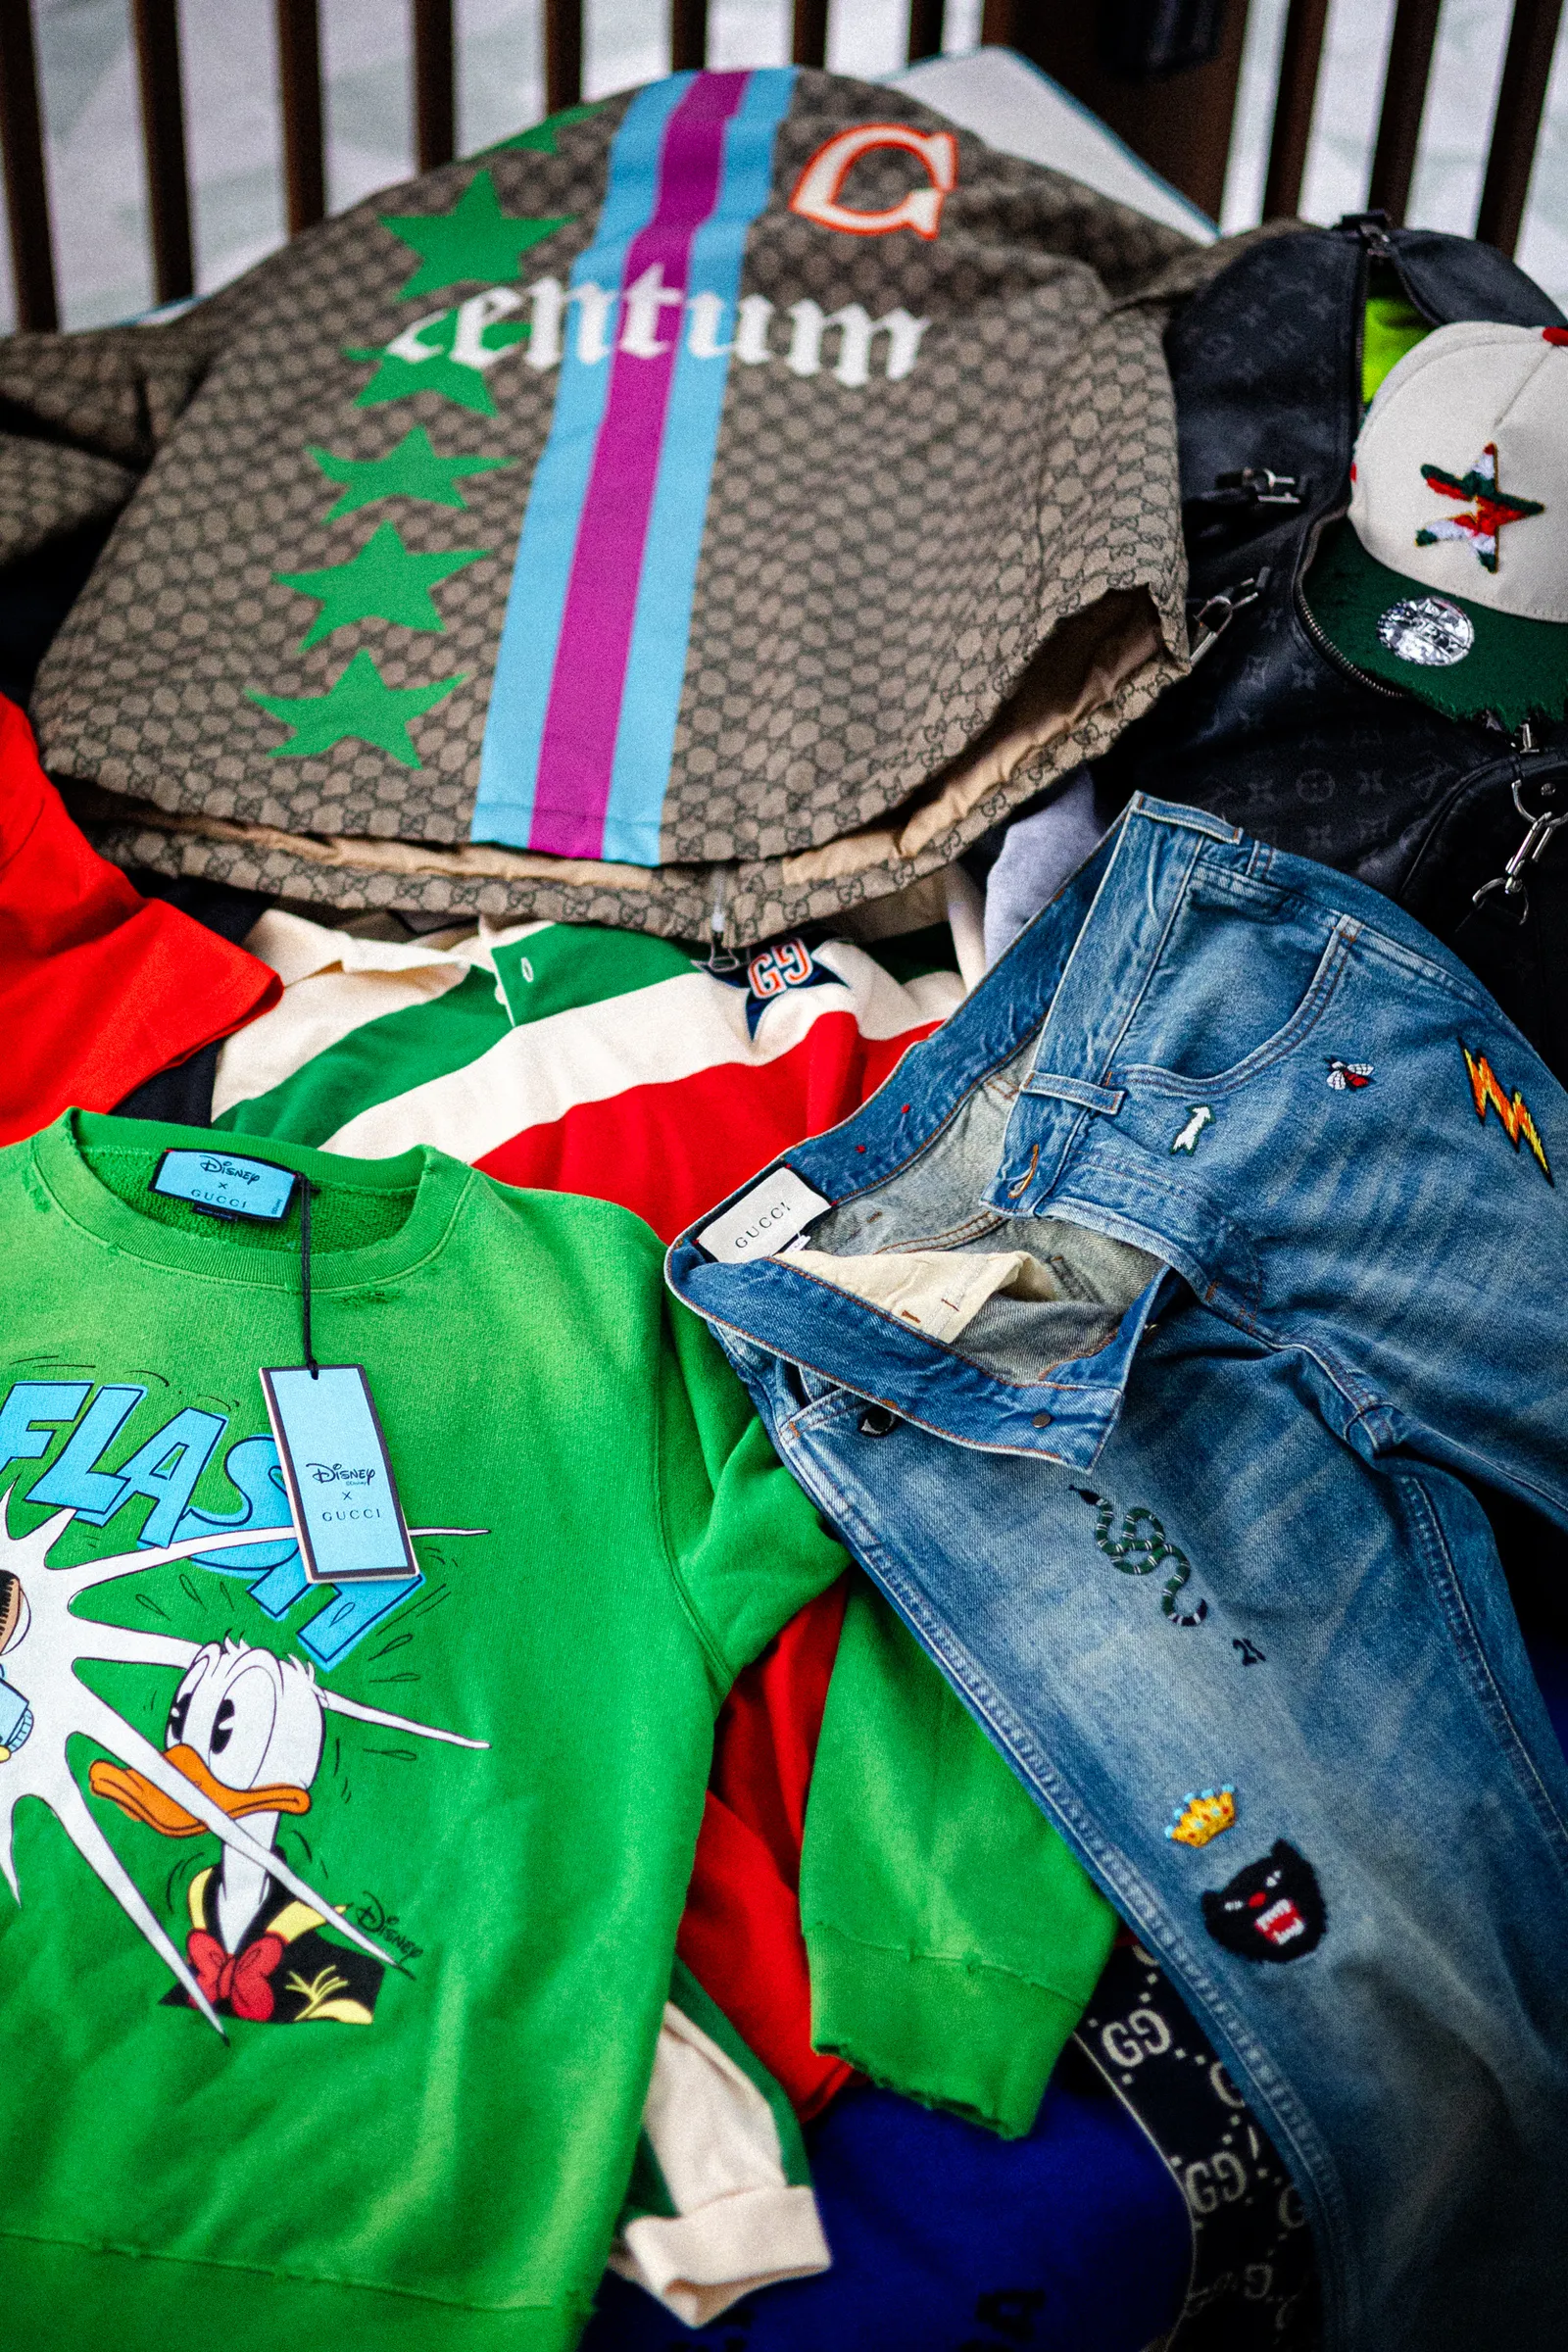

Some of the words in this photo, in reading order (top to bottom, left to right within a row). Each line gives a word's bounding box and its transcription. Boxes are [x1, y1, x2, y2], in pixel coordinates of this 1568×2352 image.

[191, 1188, 247, 1208] GUCCI
[735, 1201, 791, 1249] GUCCI
[321, 1508, 381, 1522] GUCCI
